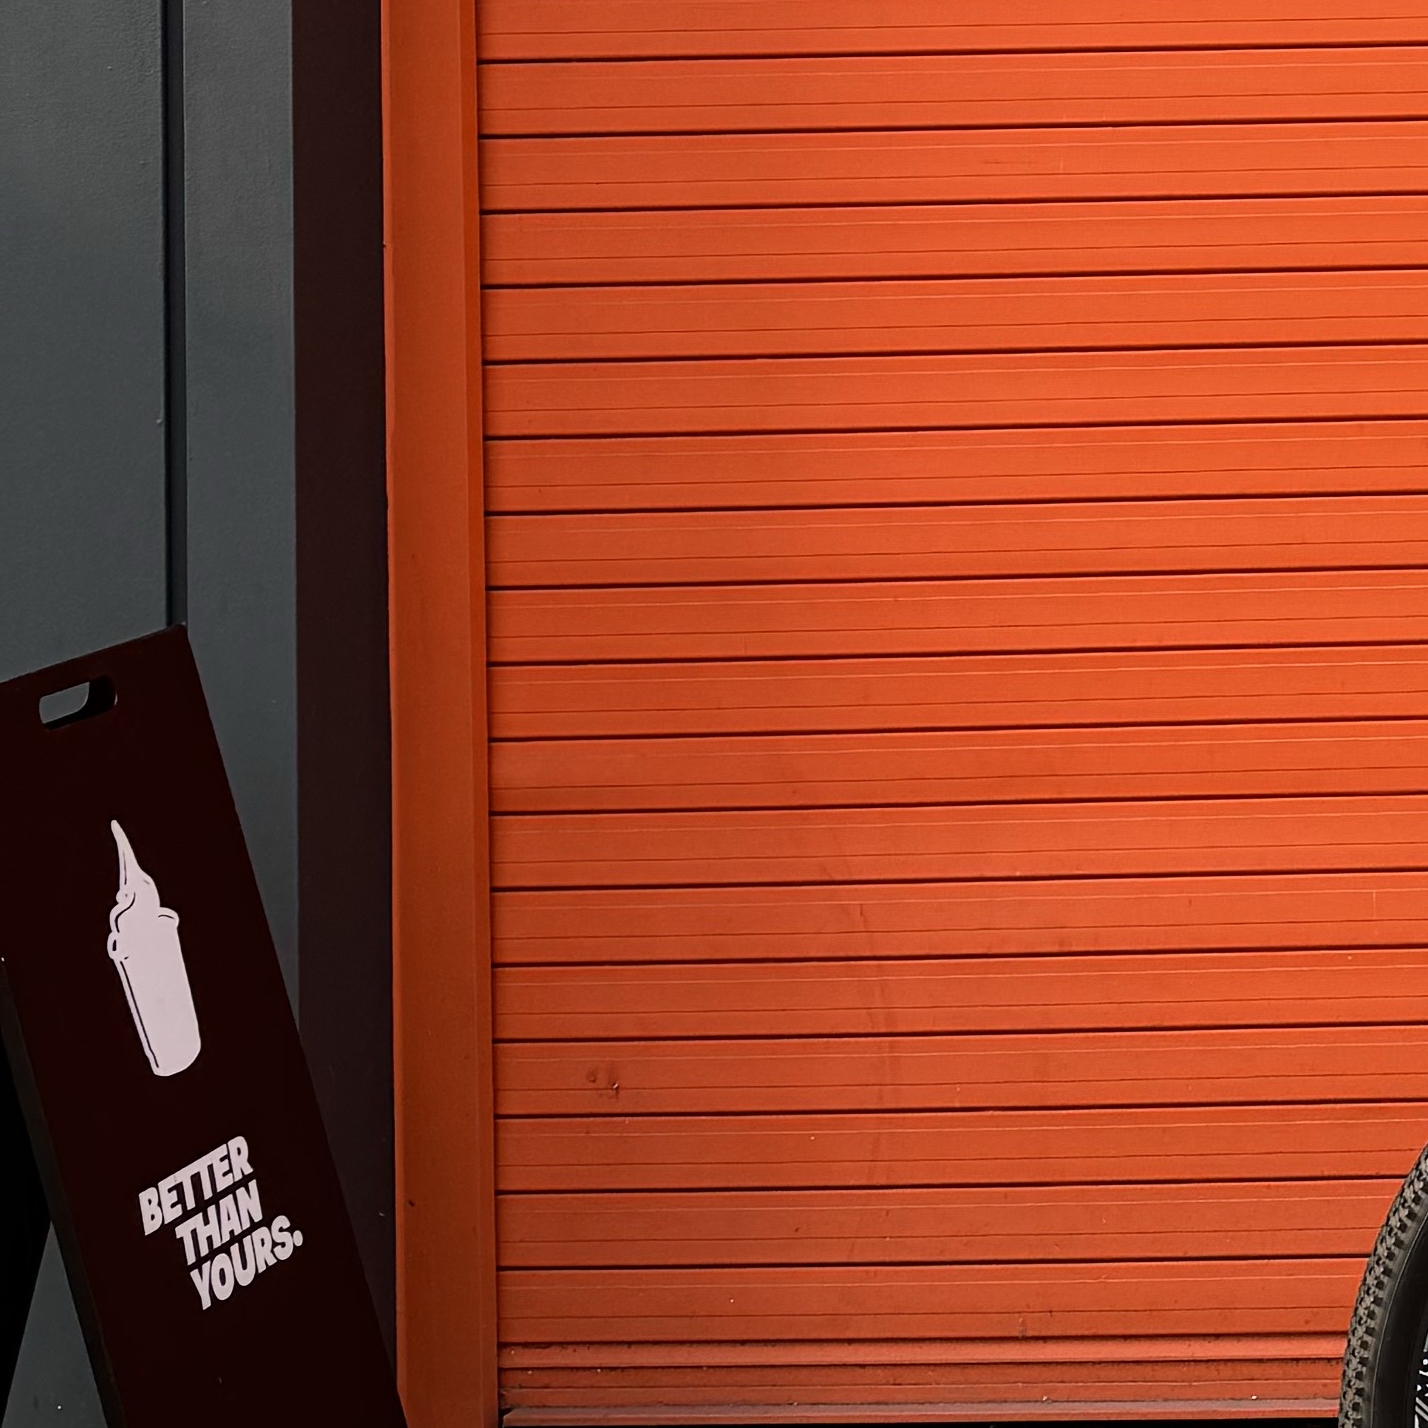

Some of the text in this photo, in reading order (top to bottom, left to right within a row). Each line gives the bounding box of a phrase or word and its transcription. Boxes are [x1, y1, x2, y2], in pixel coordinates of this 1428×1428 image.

[138, 1135, 254, 1236] BETTER
[174, 1178, 264, 1266] THAN
[189, 1214, 304, 1311] YOURS.
